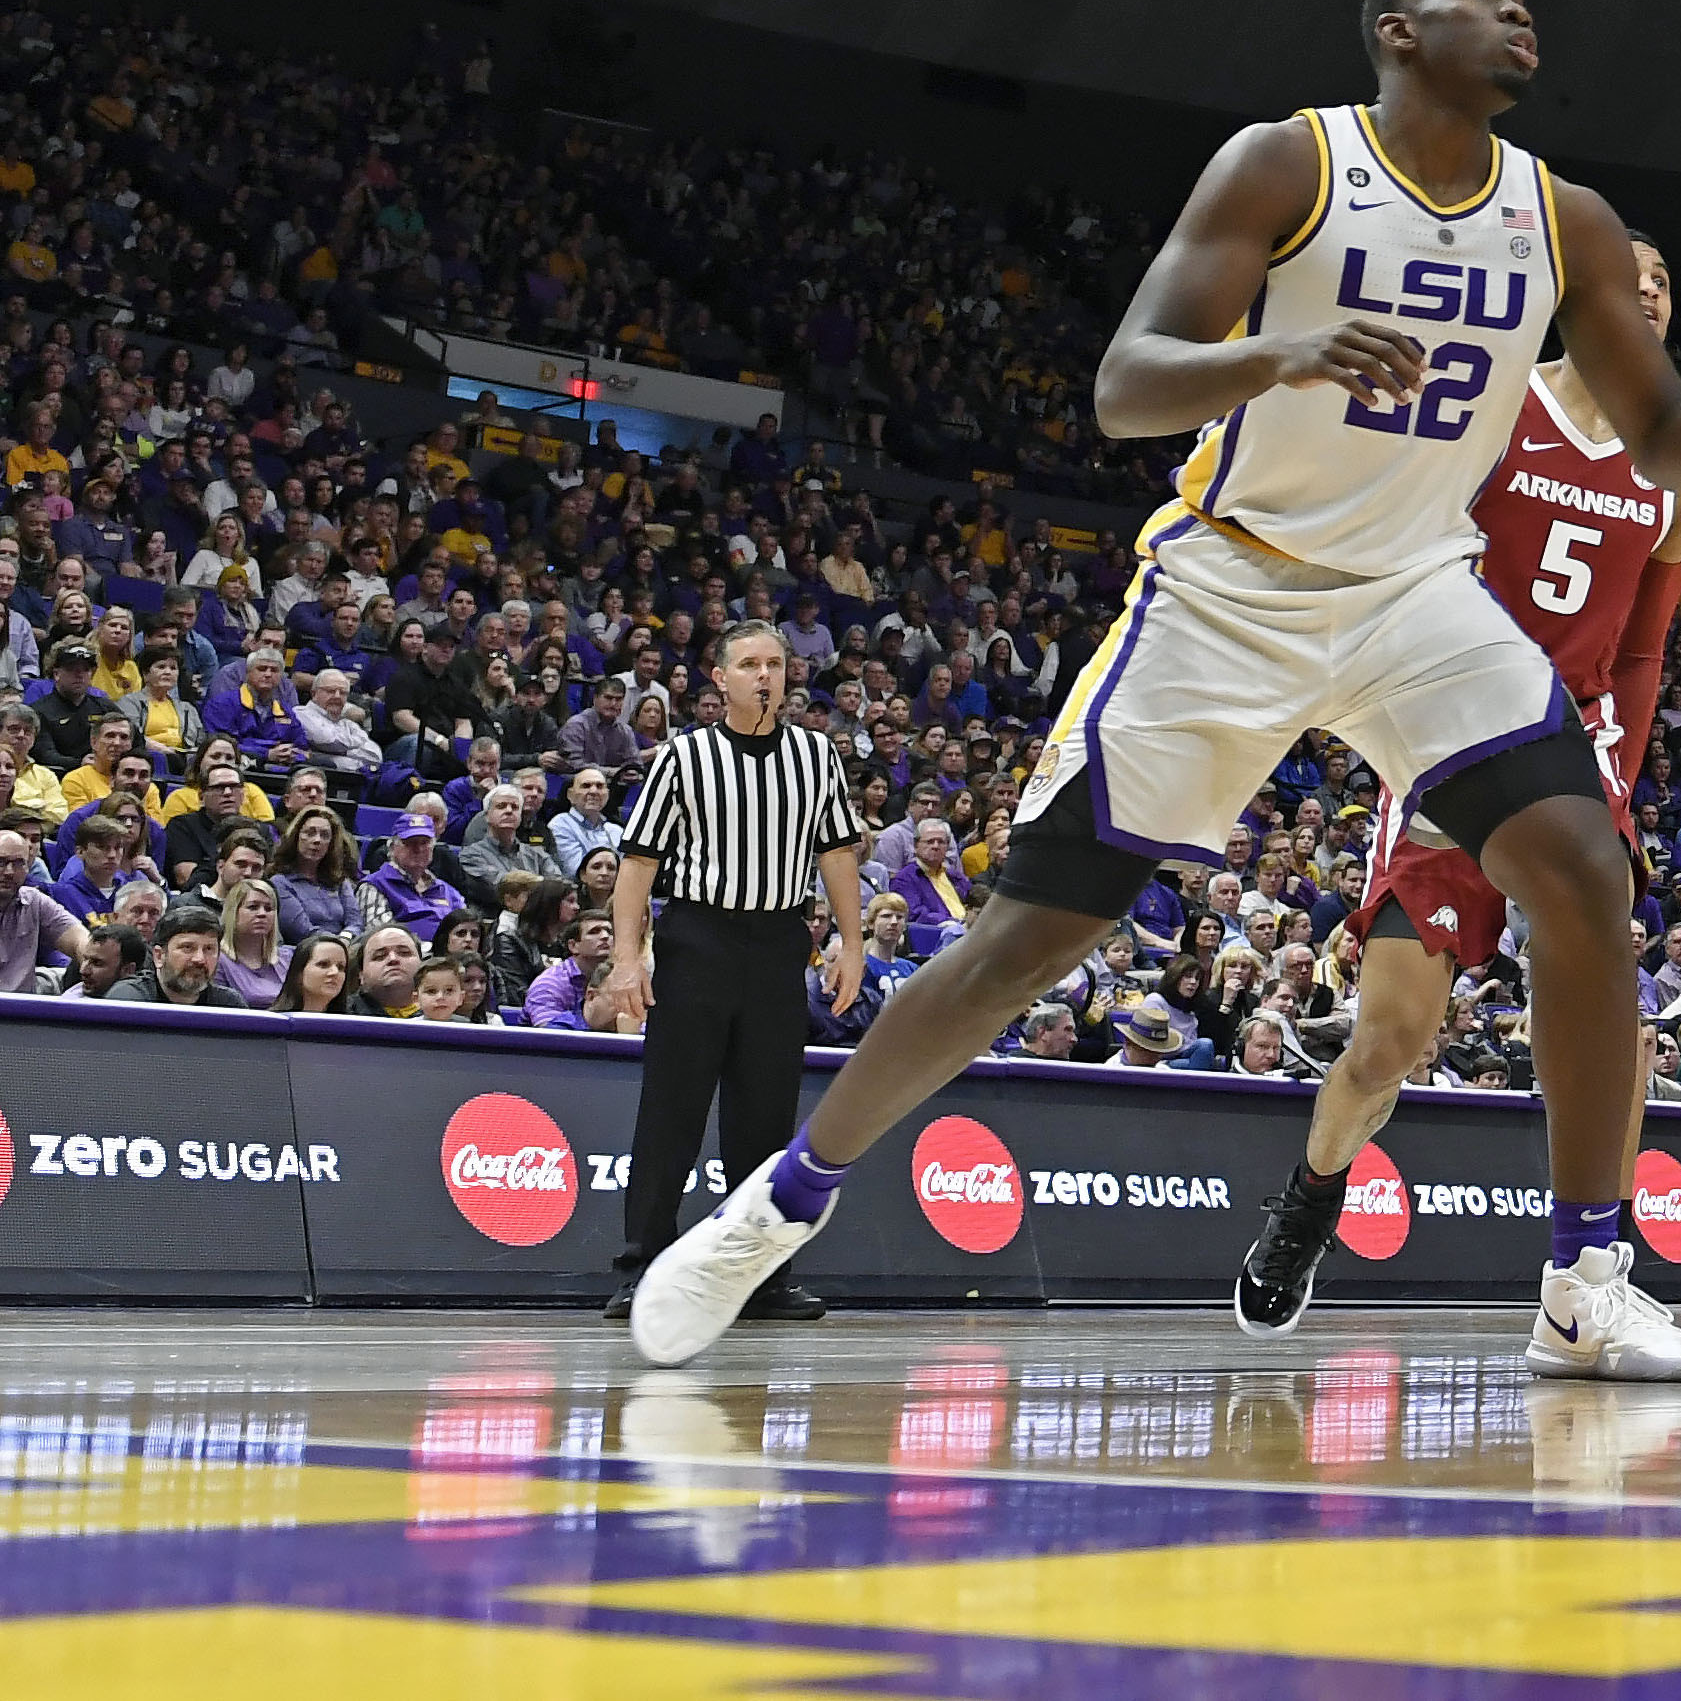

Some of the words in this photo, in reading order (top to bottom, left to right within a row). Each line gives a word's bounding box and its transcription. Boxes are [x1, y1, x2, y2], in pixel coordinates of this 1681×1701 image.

[1335, 247, 1527, 331] LSU
[1506, 470, 1656, 528] ARKANSAS
[1531, 519, 1603, 615] 5
[29, 1133, 167, 1179] zero
[179, 1141, 340, 1183] SUGAR
[1029, 1169, 1119, 1206] zero
[1127, 1177, 1231, 1210] SUGAR
[1414, 1184, 1488, 1216] zero
